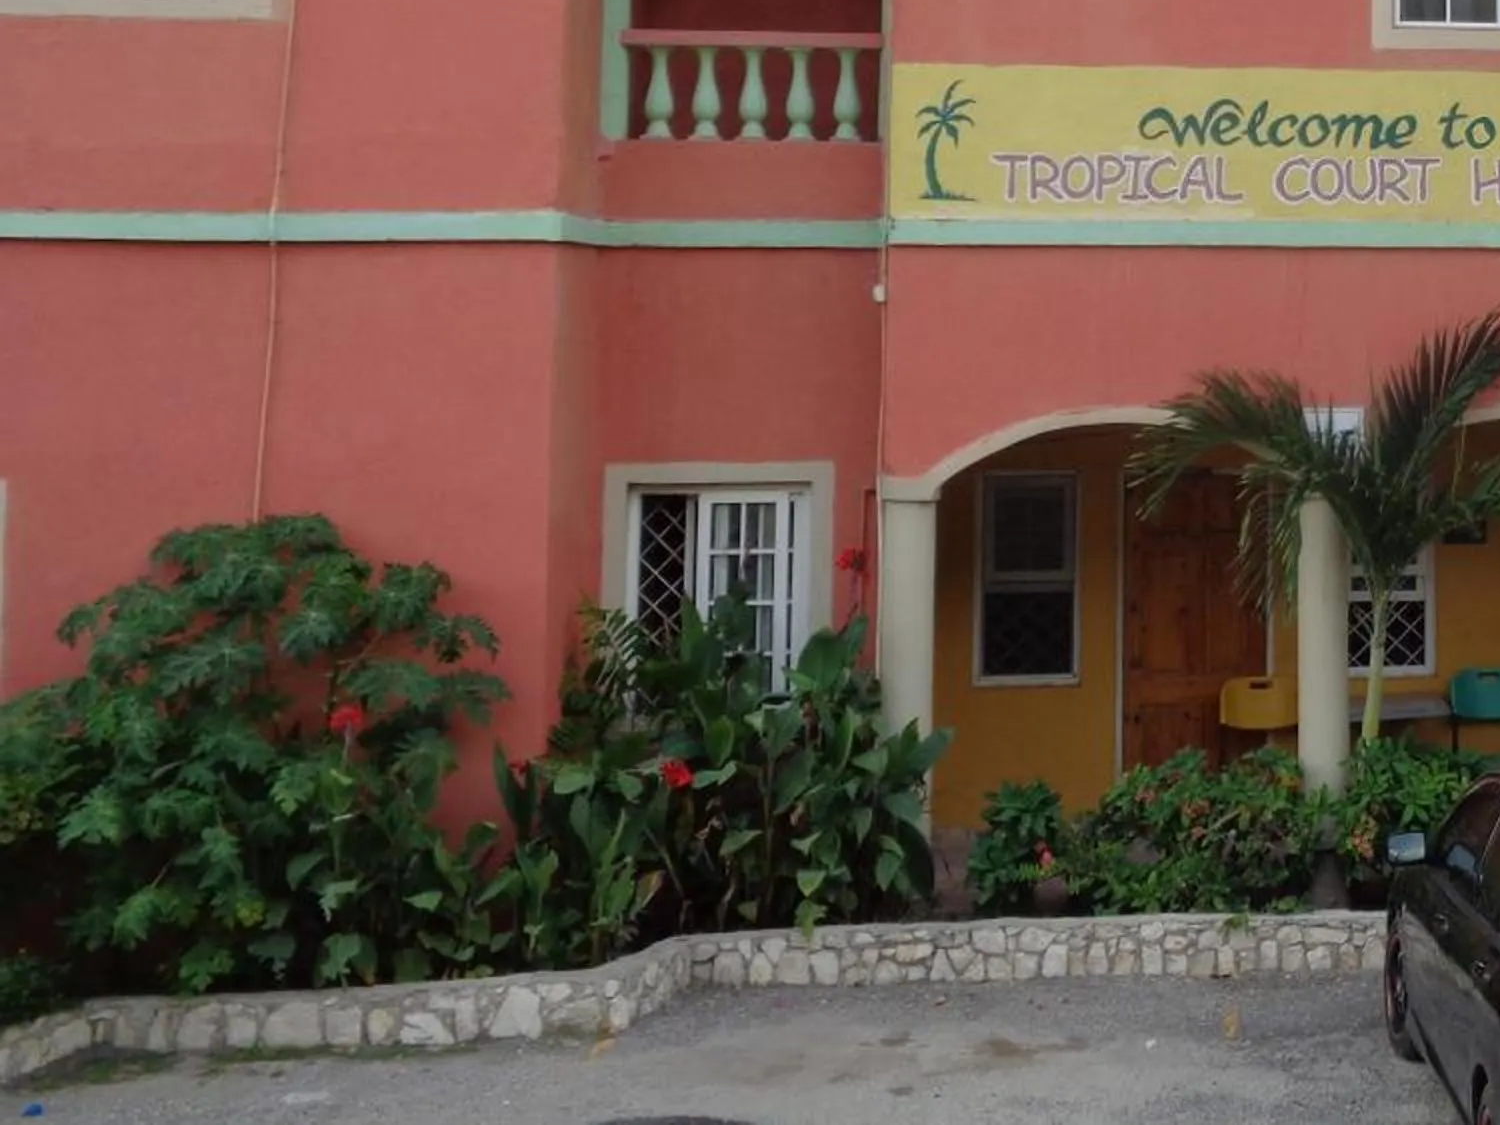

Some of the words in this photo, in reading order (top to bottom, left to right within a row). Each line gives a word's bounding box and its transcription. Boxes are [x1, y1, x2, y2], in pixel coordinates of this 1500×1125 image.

[1138, 98, 1417, 150] Welcome
[1439, 102, 1497, 150] to
[991, 152, 1245, 203] TROPICAL
[1274, 154, 1441, 204] COURT
